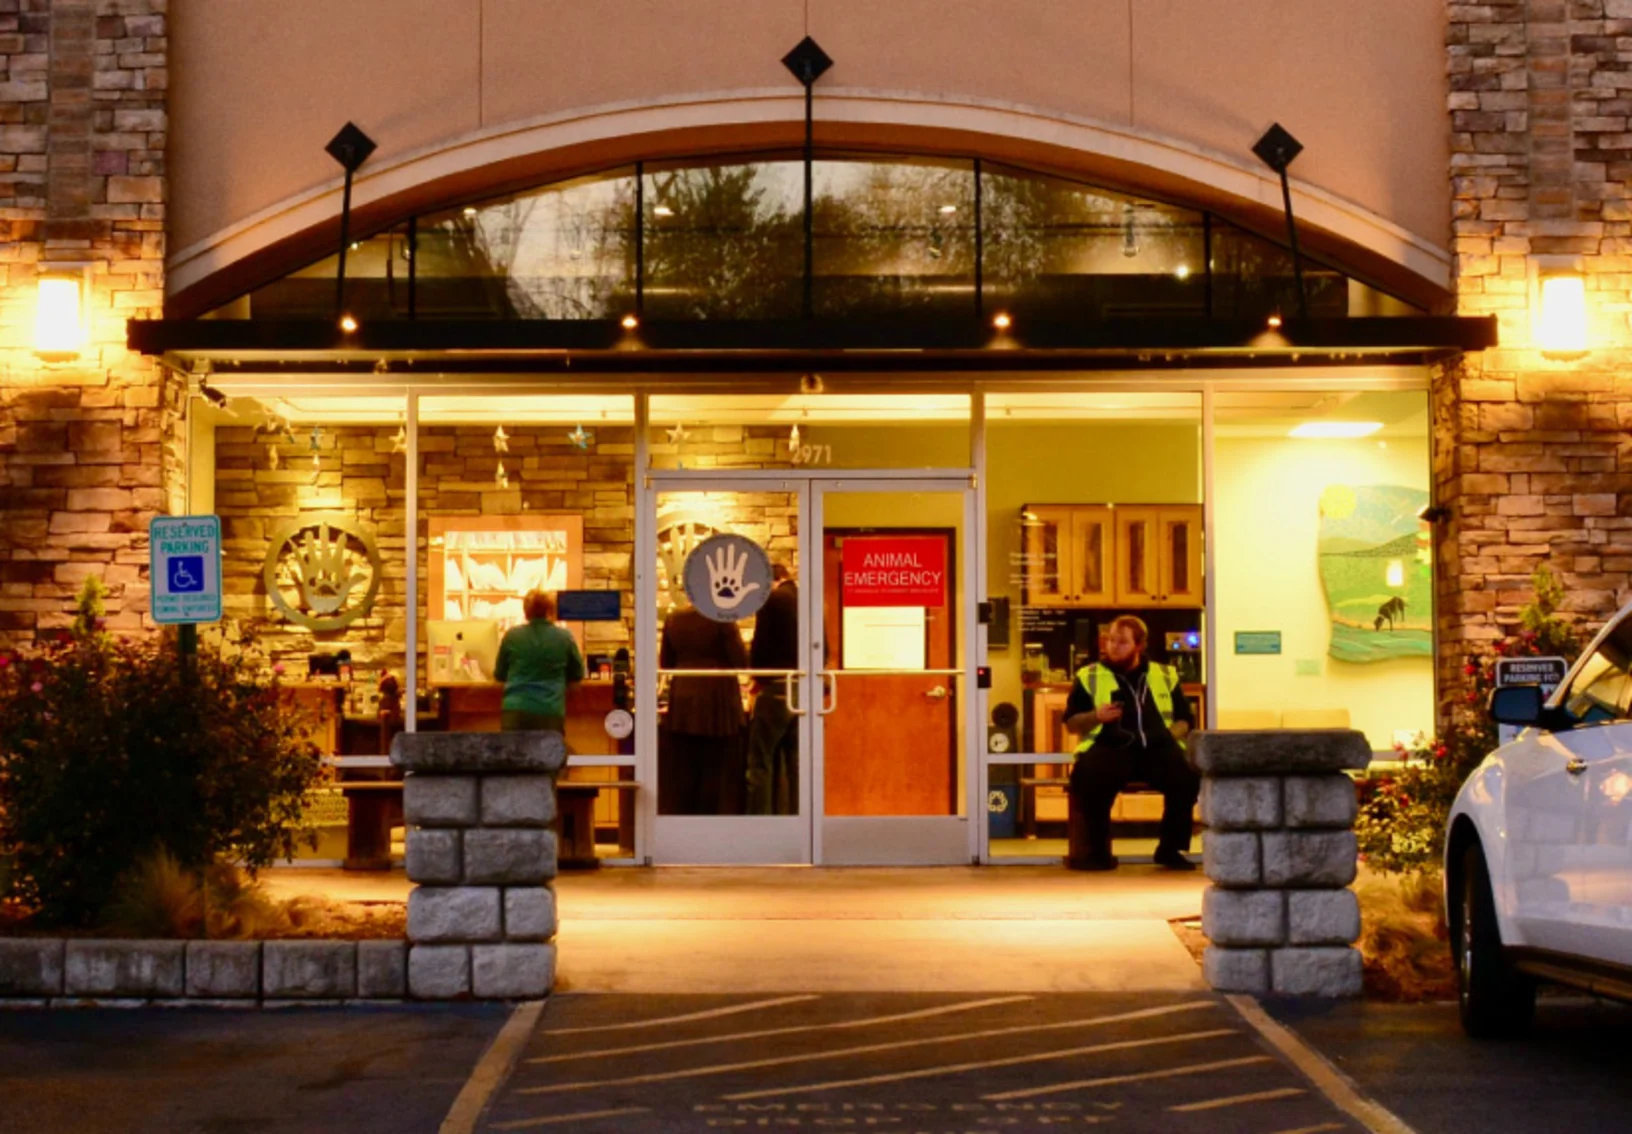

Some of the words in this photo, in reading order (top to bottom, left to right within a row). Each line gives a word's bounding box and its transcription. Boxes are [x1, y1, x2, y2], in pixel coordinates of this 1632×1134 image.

[791, 444, 832, 464] 2971
[154, 525, 216, 539] RESERVED
[160, 541, 209, 554] PARKING
[862, 552, 923, 568] ANIMAL
[843, 570, 942, 586] EMERGENCY
